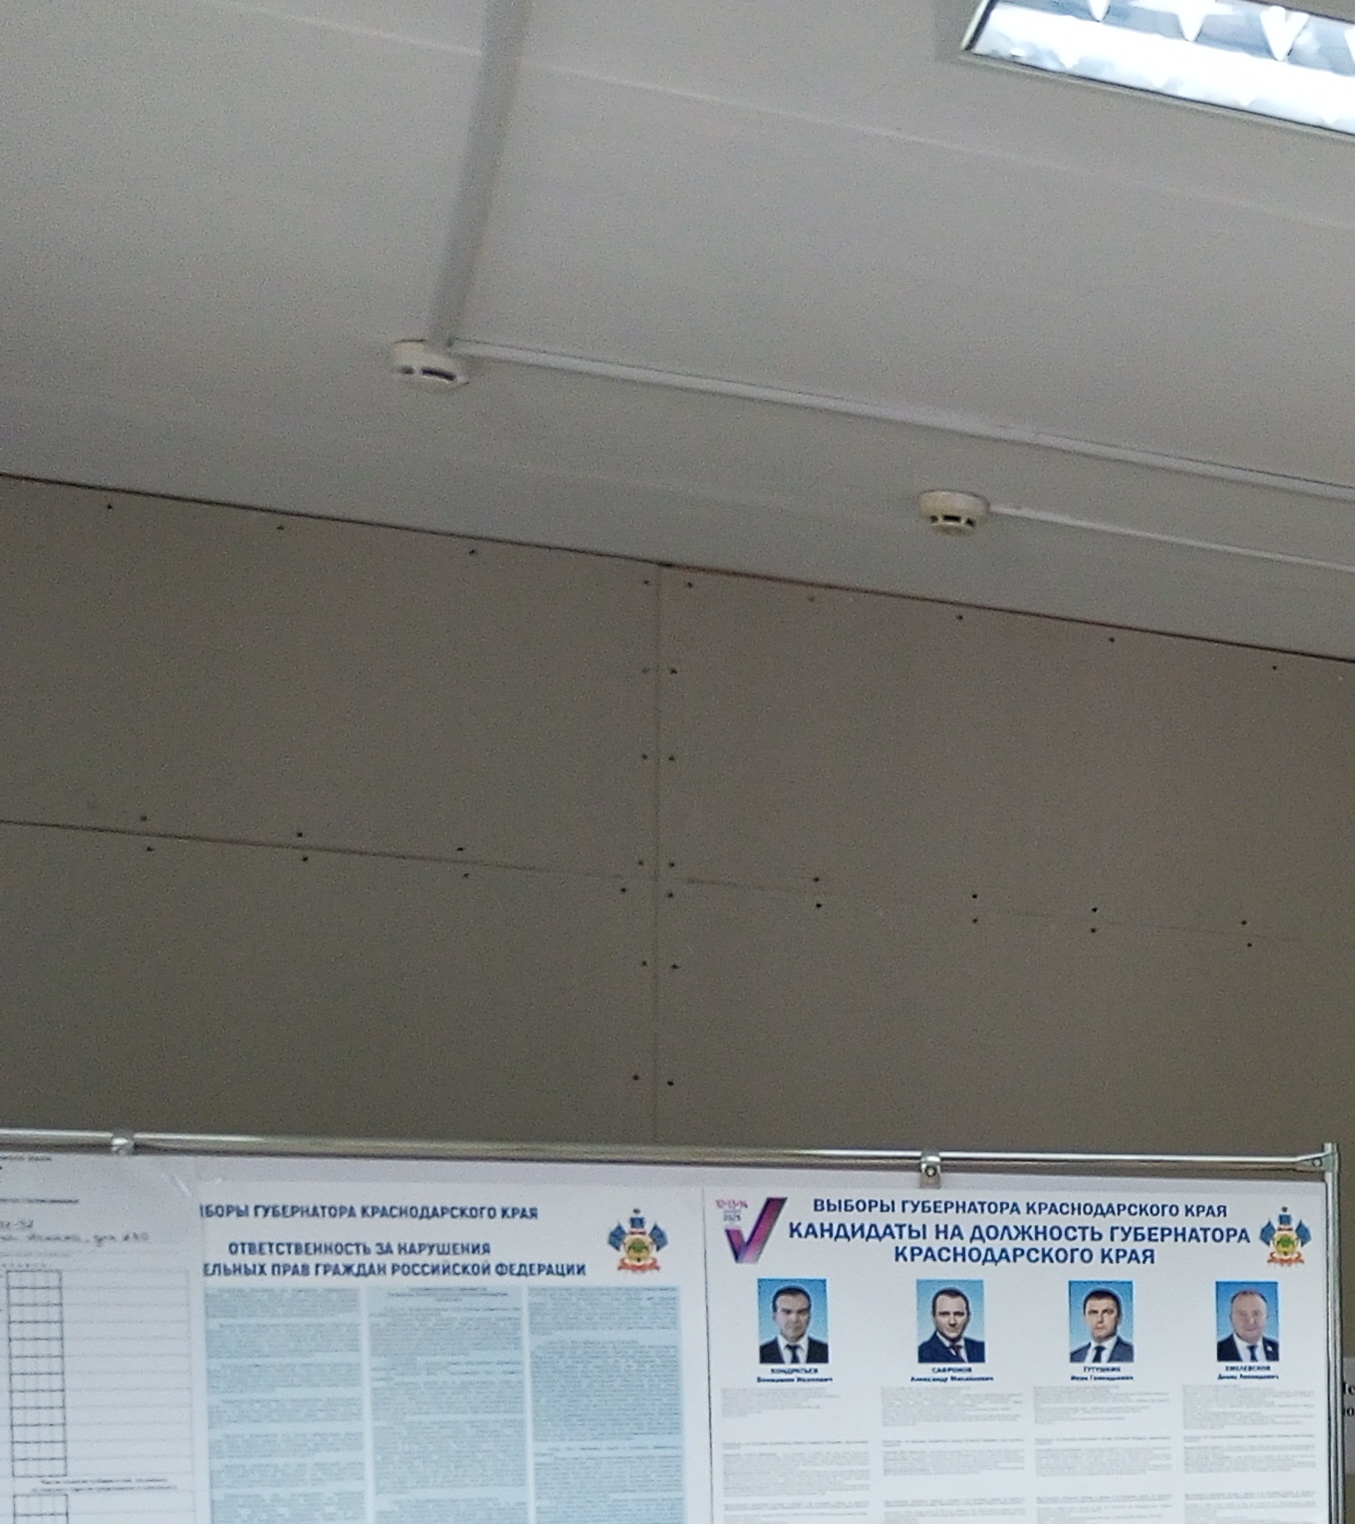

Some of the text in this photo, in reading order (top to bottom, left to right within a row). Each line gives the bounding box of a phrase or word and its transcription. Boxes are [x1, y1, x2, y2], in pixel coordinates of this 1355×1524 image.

[254, 1204, 357, 1218] ГУБЕРНАТОРА
[361, 1204, 497, 1219] КРАСНОДАРСКОГО
[501, 1206, 539, 1219] КРАЯ
[813, 1199, 1227, 1218] ВЫБОРЫ ГУБЕРНАТОРА КРАСНОДАРСКОГО КРАЯ
[789, 1221, 1251, 1243] КАНДИДАТЫ НА ДОЛЖНОСТЬ ГУБЕРНАТОРА
[228, 1241, 491, 1256] ОТВЕТСТВЕННОСТЬ ЗА НАРУШЕНИЯ
[894, 1246, 1156, 1267] КРАСНОДАРСКОГО КРАЯ
[271, 1262, 310, 1277] ПРАВ
[315, 1263, 387, 1278] ГРАЖДАН
[391, 1259, 491, 1276] РОССИЙСКОЙ
[495, 1262, 587, 1278] ФЕДЕРАЦИИ
